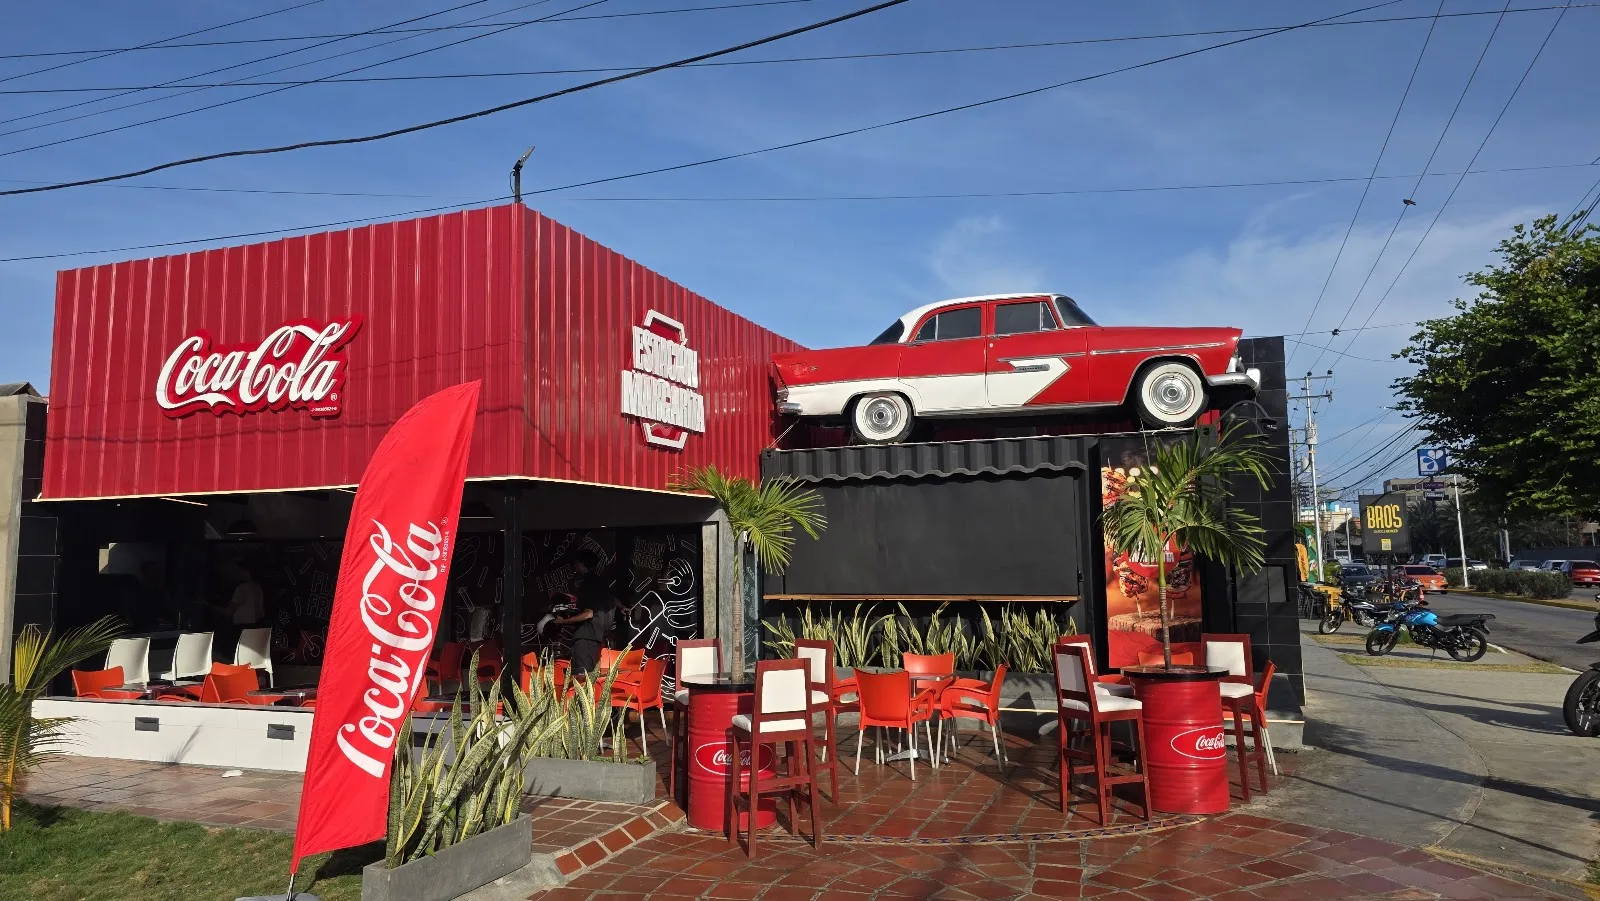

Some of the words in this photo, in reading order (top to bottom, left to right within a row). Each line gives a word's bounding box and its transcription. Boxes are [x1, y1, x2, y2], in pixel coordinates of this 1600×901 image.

[156, 321, 352, 409] Coca-Cola
[621, 369, 706, 433] MARGARITA
[1366, 503, 1403, 529] BRO'S
[336, 518, 444, 778] Coca-Cola
